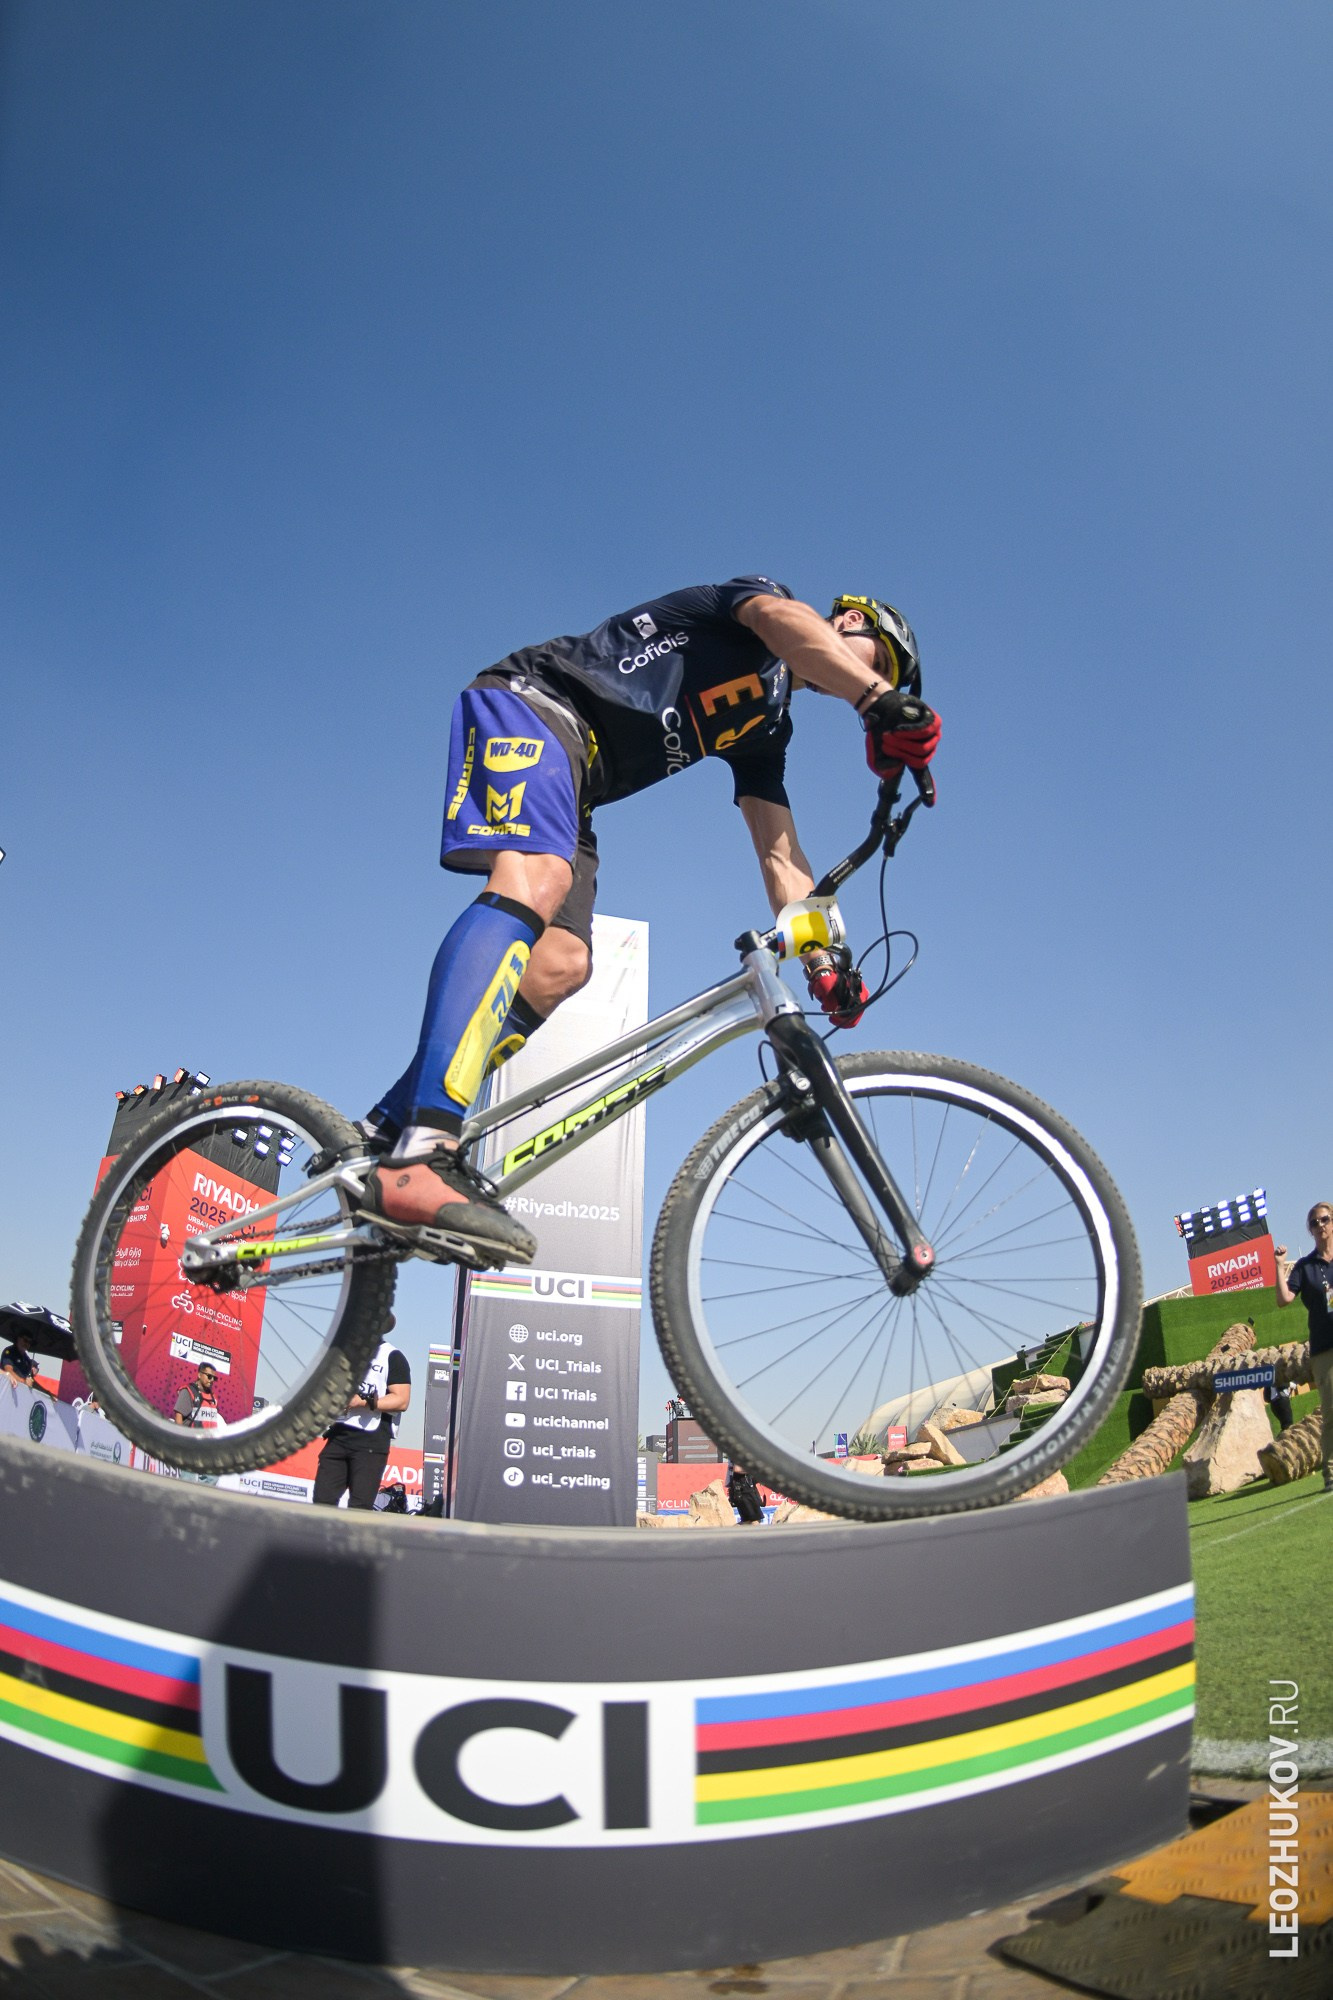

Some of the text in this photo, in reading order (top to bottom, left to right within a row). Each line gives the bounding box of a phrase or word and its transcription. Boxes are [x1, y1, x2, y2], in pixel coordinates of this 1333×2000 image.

[618, 631, 690, 674] Cofidis
[490, 742, 537, 758] WD-40
[447, 727, 476, 820] COMAS
[467, 822, 531, 837] COMAS
[710, 1122, 740, 1161] TIRE
[190, 1196, 227, 1225] 2025
[504, 1197, 620, 1221] #Riyadh2025
[1207, 1251, 1259, 1278] RIYADH
[534, 1276, 585, 1299] UCI
[1211, 1266, 1262, 1290] 2025 UCI
[196, 1304, 216, 1316] SAUDI
[217, 1312, 242, 1327] CYCLING
[175, 1336, 191, 1348] UCI
[536, 1330, 583, 1346] uci.org
[535, 1358, 602, 1374] UCI_Trials
[1214, 1371, 1273, 1387] SHIMANO
[534, 1386, 598, 1401] UCI Trials
[533, 1415, 609, 1430] ucichannel
[1009, 1400, 1094, 1477] NATIONAL
[532, 1445, 597, 1460] uci_trials
[243, 1478, 261, 1488] UCI
[531, 1472, 611, 1490] uci_cycling
[225, 1662, 651, 1832] UCI
